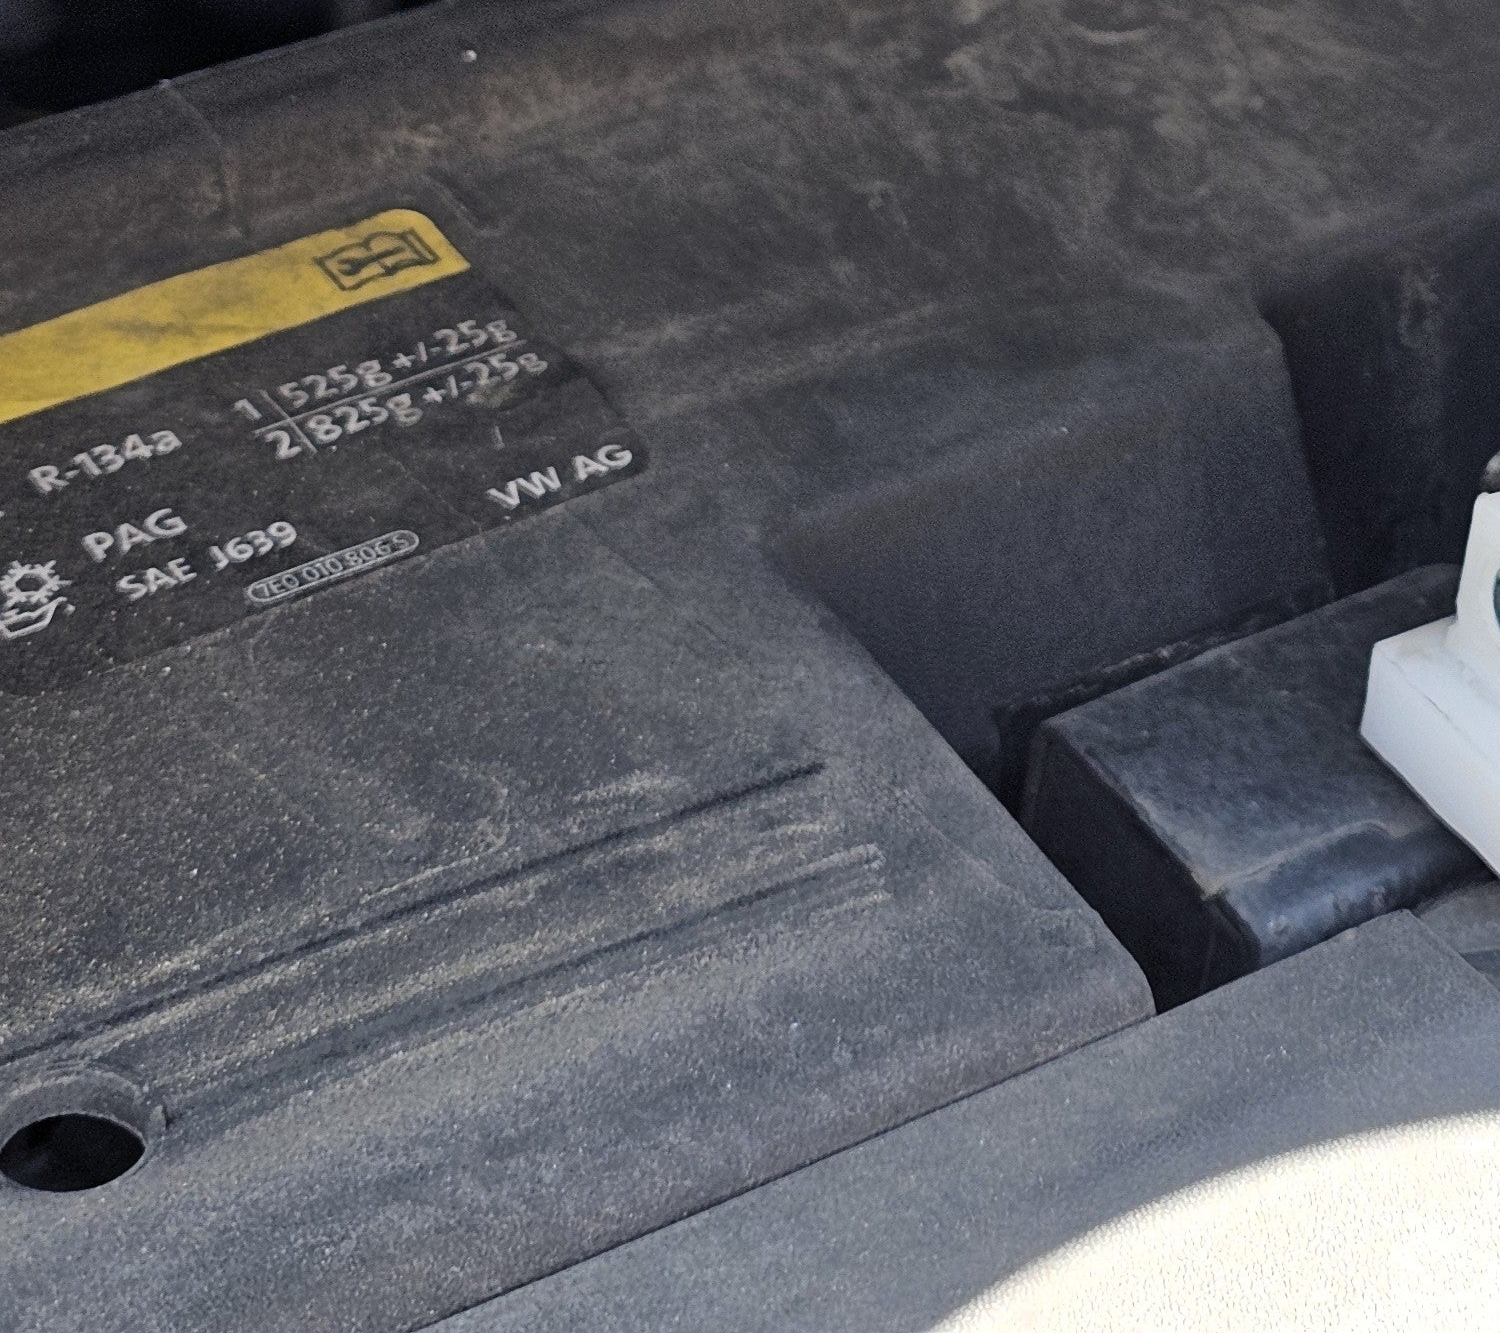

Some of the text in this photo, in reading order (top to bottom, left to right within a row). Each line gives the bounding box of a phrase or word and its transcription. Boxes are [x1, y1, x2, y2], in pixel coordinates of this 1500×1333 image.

[26, 428, 183, 494] R-134a
[487, 443, 634, 510] VW AG
[82, 506, 188, 563] PAG
[116, 521, 298, 601] SAE J639
